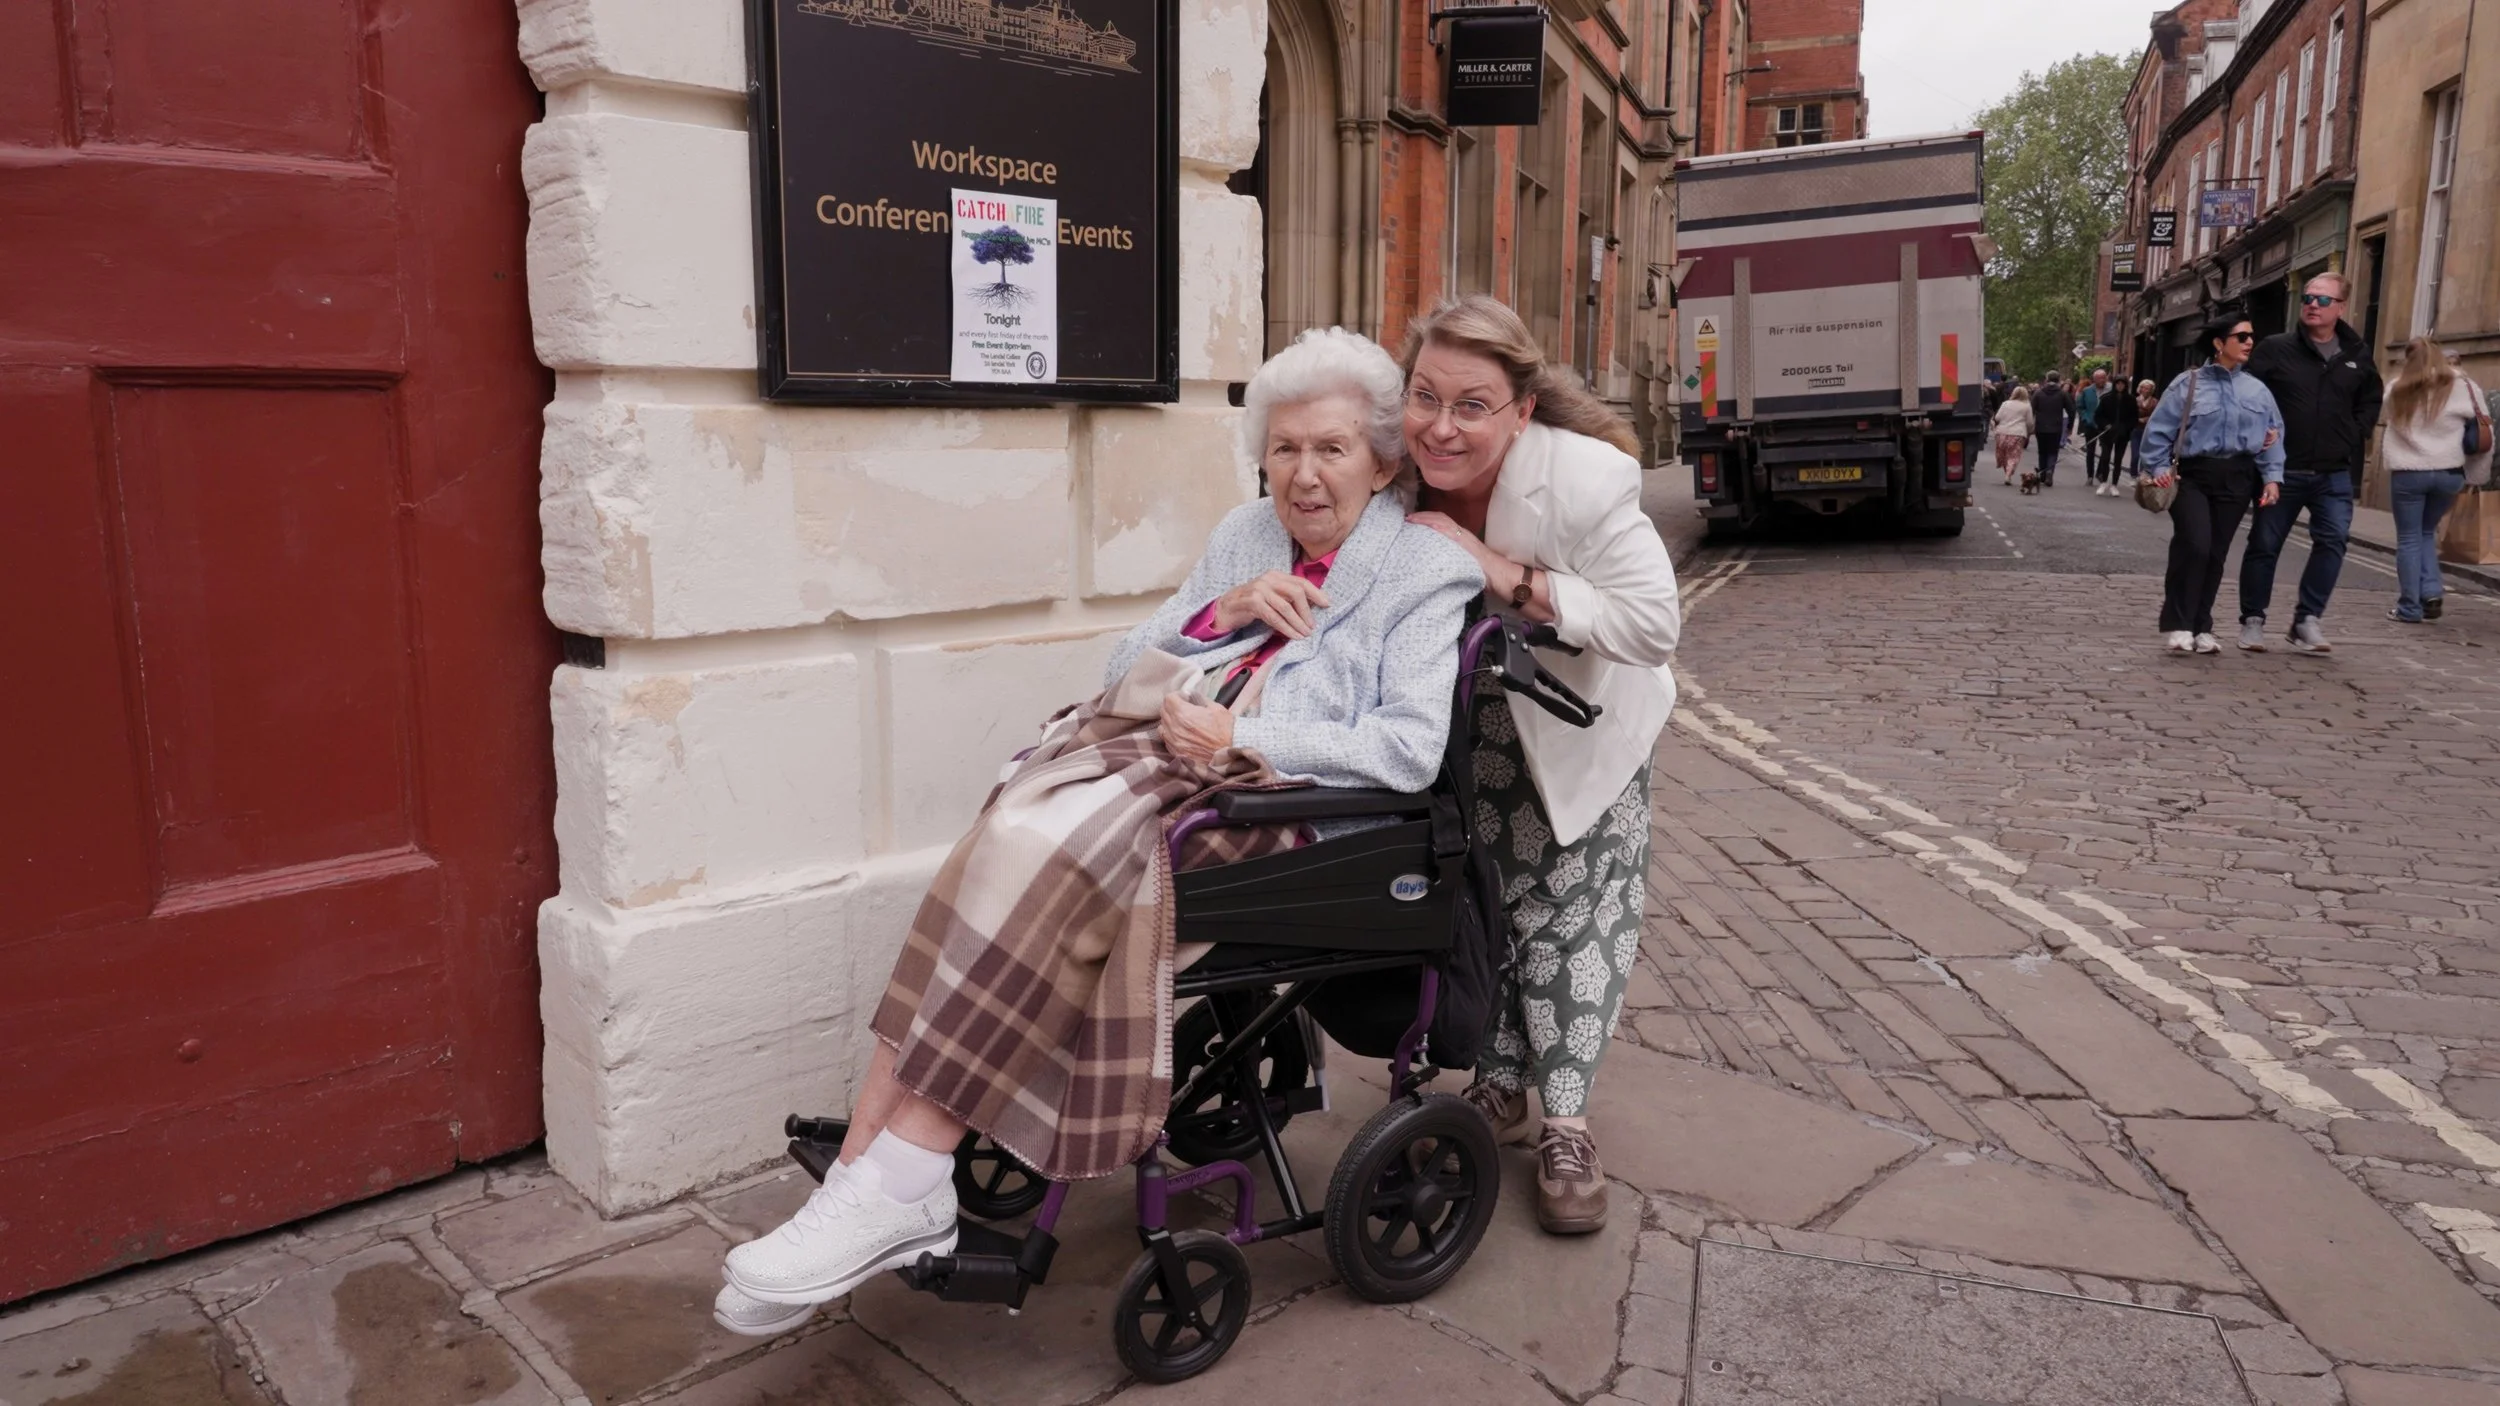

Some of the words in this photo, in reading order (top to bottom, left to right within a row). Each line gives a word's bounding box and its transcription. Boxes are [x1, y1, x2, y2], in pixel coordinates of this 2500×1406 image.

[1457, 64, 1489, 73] MILLER
[1490, 64, 1498, 72] &
[1499, 63, 1533, 72] CARTER
[1464, 74, 1523, 83] STEAKHOUSE
[912, 140, 1057, 186] Workspace
[816, 194, 952, 234] Conferen
[957, 199, 1006, 222] CATCH
[1015, 204, 1045, 226] FIRE
[1057, 217, 1133, 250] Events
[2114, 245, 2124, 253] TO
[2124, 243, 2136, 253] LET
[984, 312, 1021, 328] Tonight
[1815, 319, 1883, 333] suspension
[971, 331, 986, 339] every
[988, 330, 998, 338] first
[1023, 332, 1031, 340] the
[1033, 333, 1049, 341] month
[972, 340, 985, 349] Free
[986, 341, 1003, 349] Event
[1781, 365, 1833, 376] 2000KGS
[1835, 363, 1854, 373] Tail
